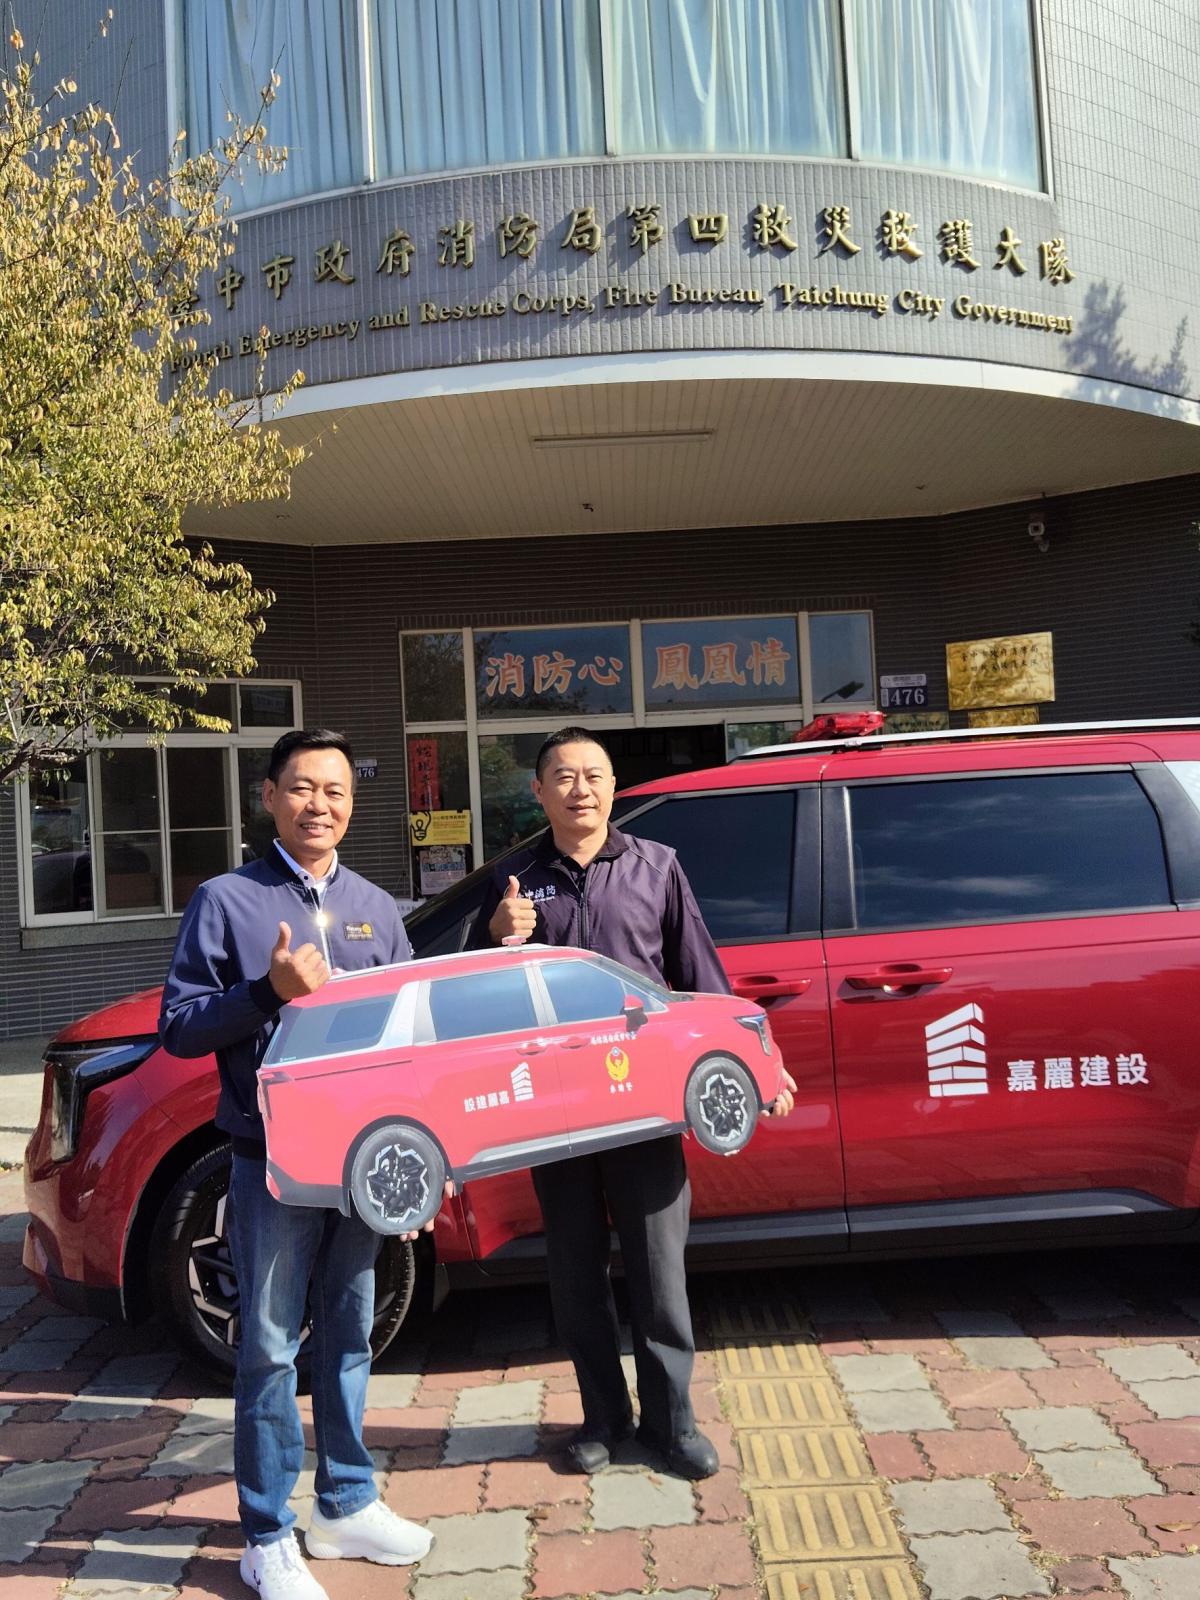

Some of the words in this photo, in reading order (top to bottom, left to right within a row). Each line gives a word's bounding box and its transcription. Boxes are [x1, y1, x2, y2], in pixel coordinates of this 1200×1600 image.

[239, 318, 360, 356] Emergency
[368, 309, 410, 331] and
[419, 301, 507, 324] Rescue
[511, 291, 596, 316] Corps,
[604, 284, 658, 309] Fire
[669, 282, 766, 308] Bureau,
[775, 282, 889, 318] Taichung
[898, 288, 945, 318] City
[954, 294, 1074, 334] Government
[485, 651, 624, 699] 消防心
[652, 637, 791, 691] 鳳凰情
[890, 688, 925, 706] 476
[1006, 1053, 1149, 1092] 嘉麗建設
